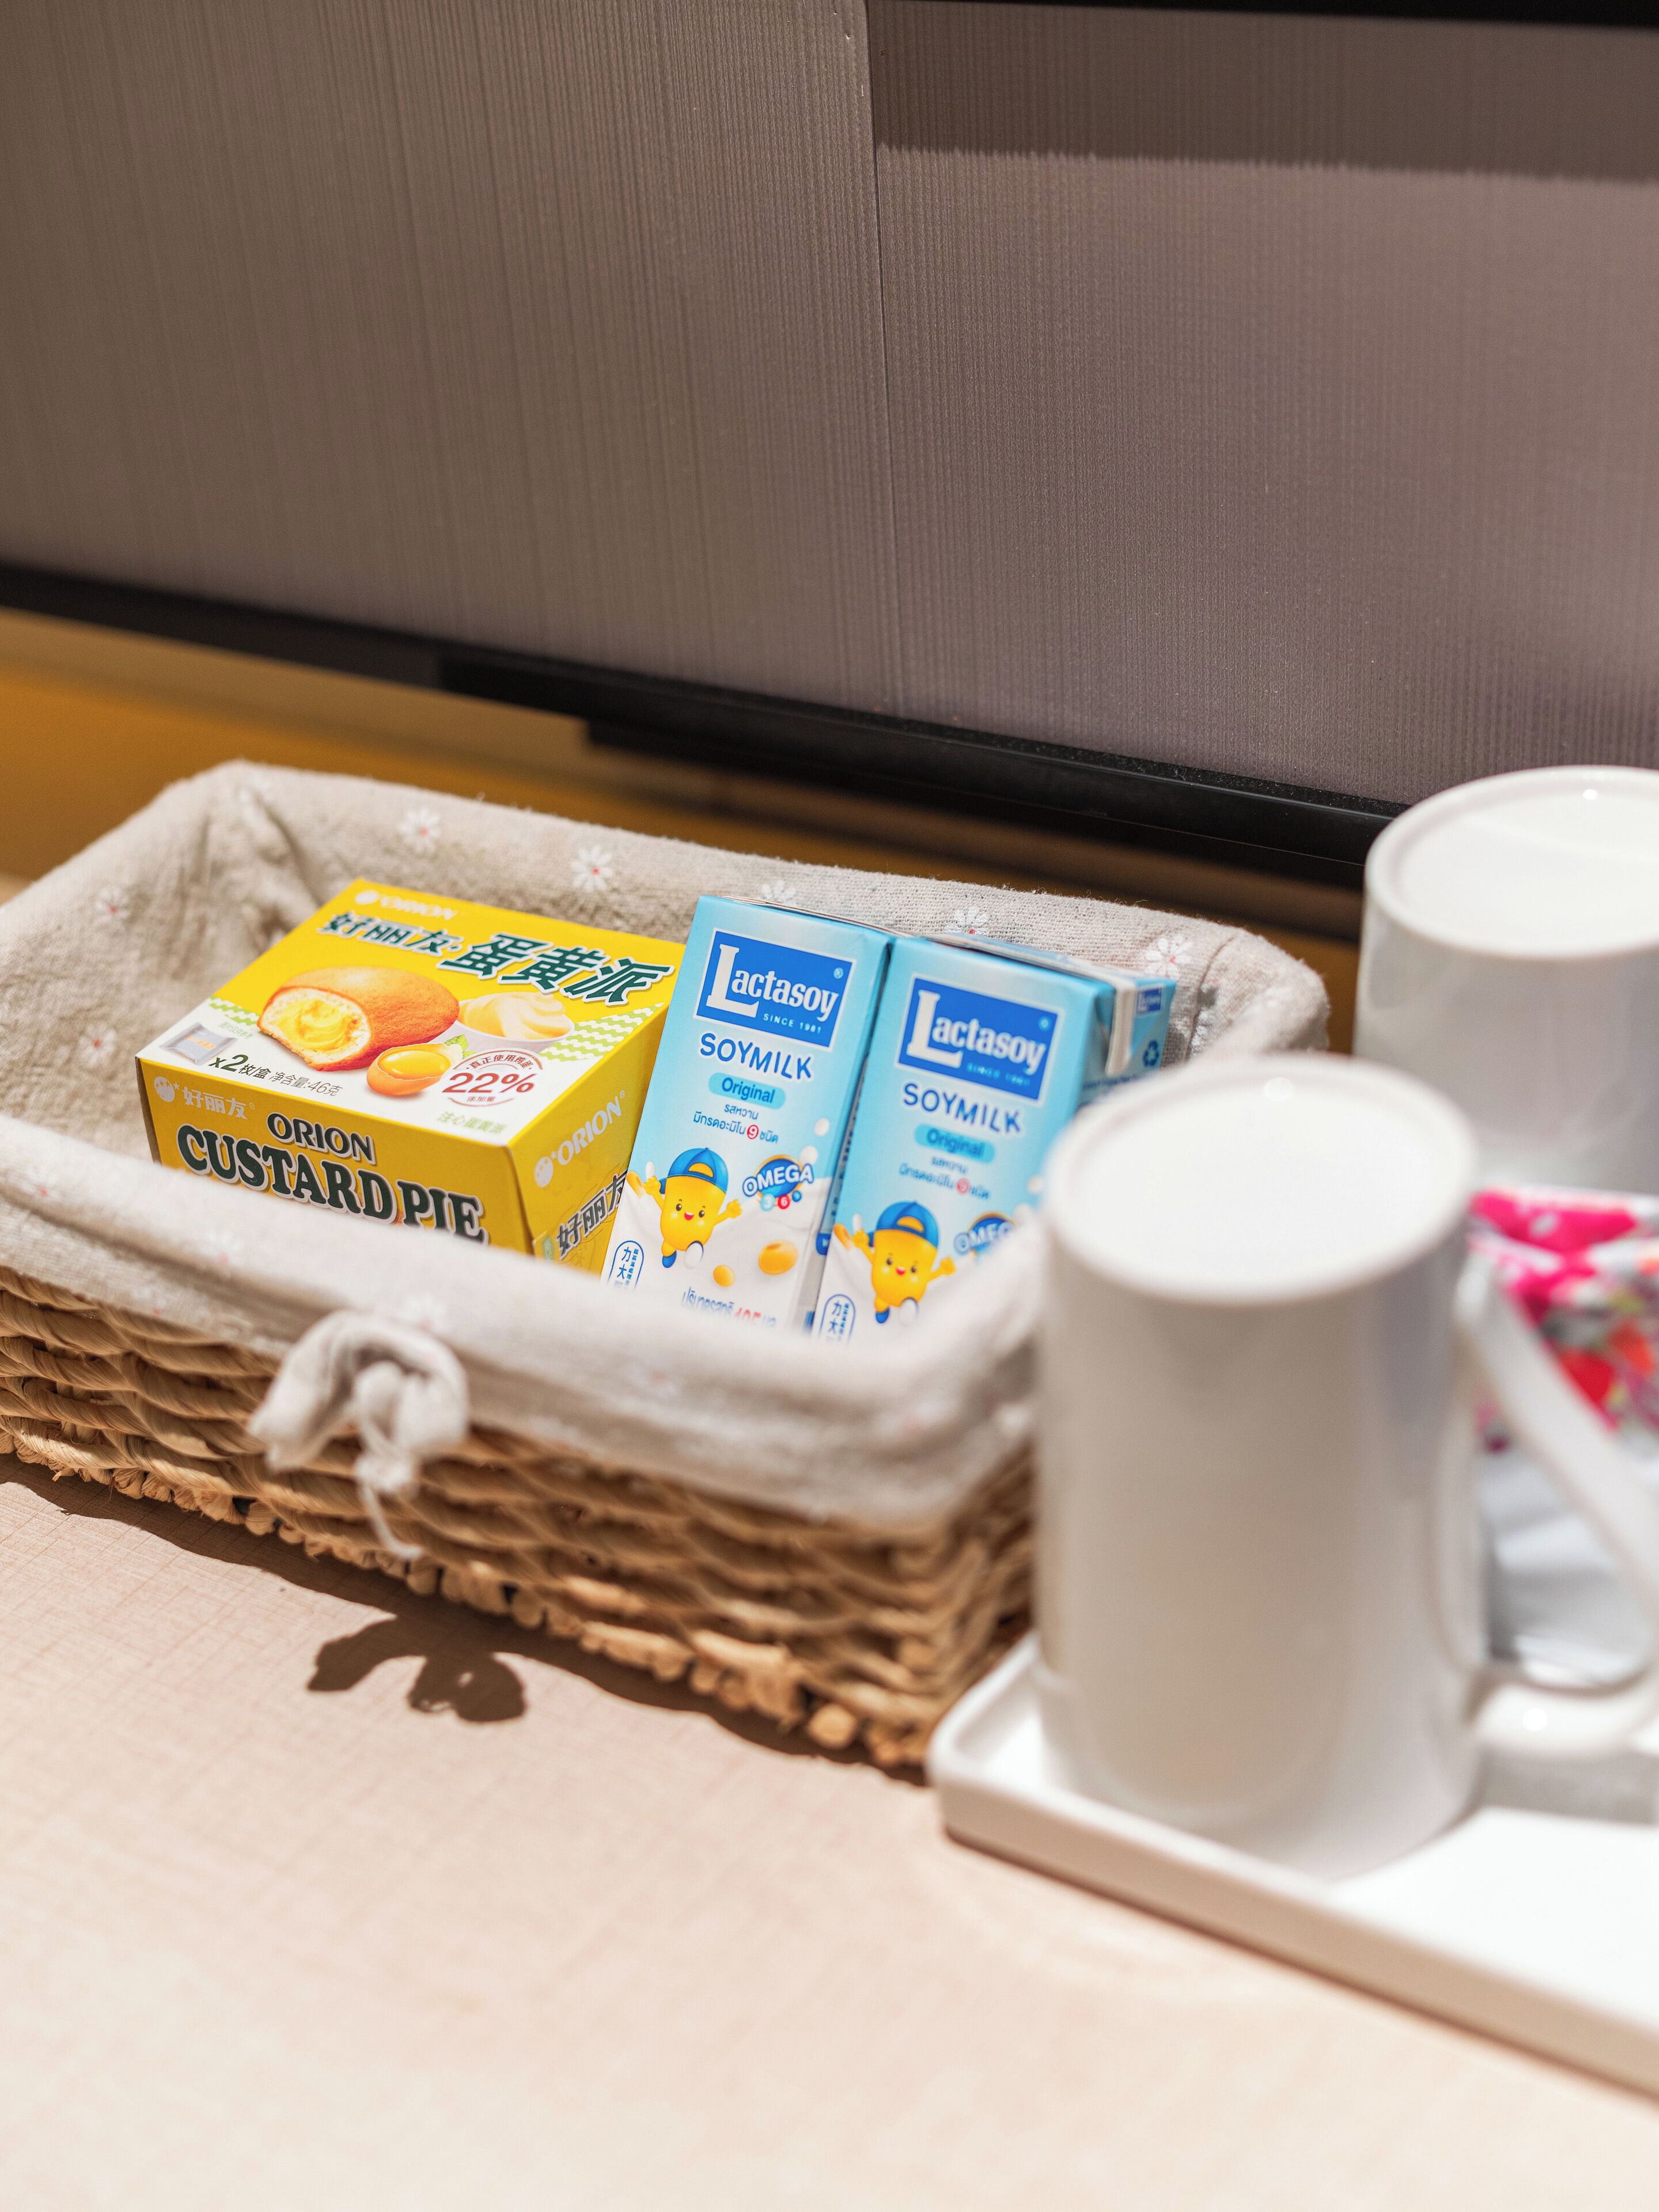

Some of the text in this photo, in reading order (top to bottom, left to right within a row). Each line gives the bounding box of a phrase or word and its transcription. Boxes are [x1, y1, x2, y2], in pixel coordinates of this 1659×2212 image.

[437, 933, 675, 1005] 蛋黄派
[706, 944, 839, 1022] Lactasoy
[763, 1013, 794, 1028] SINCE
[906, 989, 1046, 1075] Lactasoy
[700, 1033, 811, 1080] SOYMILK
[442, 1072, 538, 1093] 22%
[722, 1077, 776, 1104] Original
[182, 1086, 248, 1120] 好丽友
[724, 1104, 759, 1120] รสหวาน
[903, 1083, 1021, 1134] SOYMILK
[267, 1112, 375, 1165] ORION
[557, 1096, 622, 1166] ORION
[926, 1128, 985, 1158] Original
[176, 1123, 488, 1247] CUSTARD PIE
[742, 1163, 814, 1197] OMEGA
[614, 1247, 631, 1286] 力大
[827, 1300, 842, 1335] 力大
